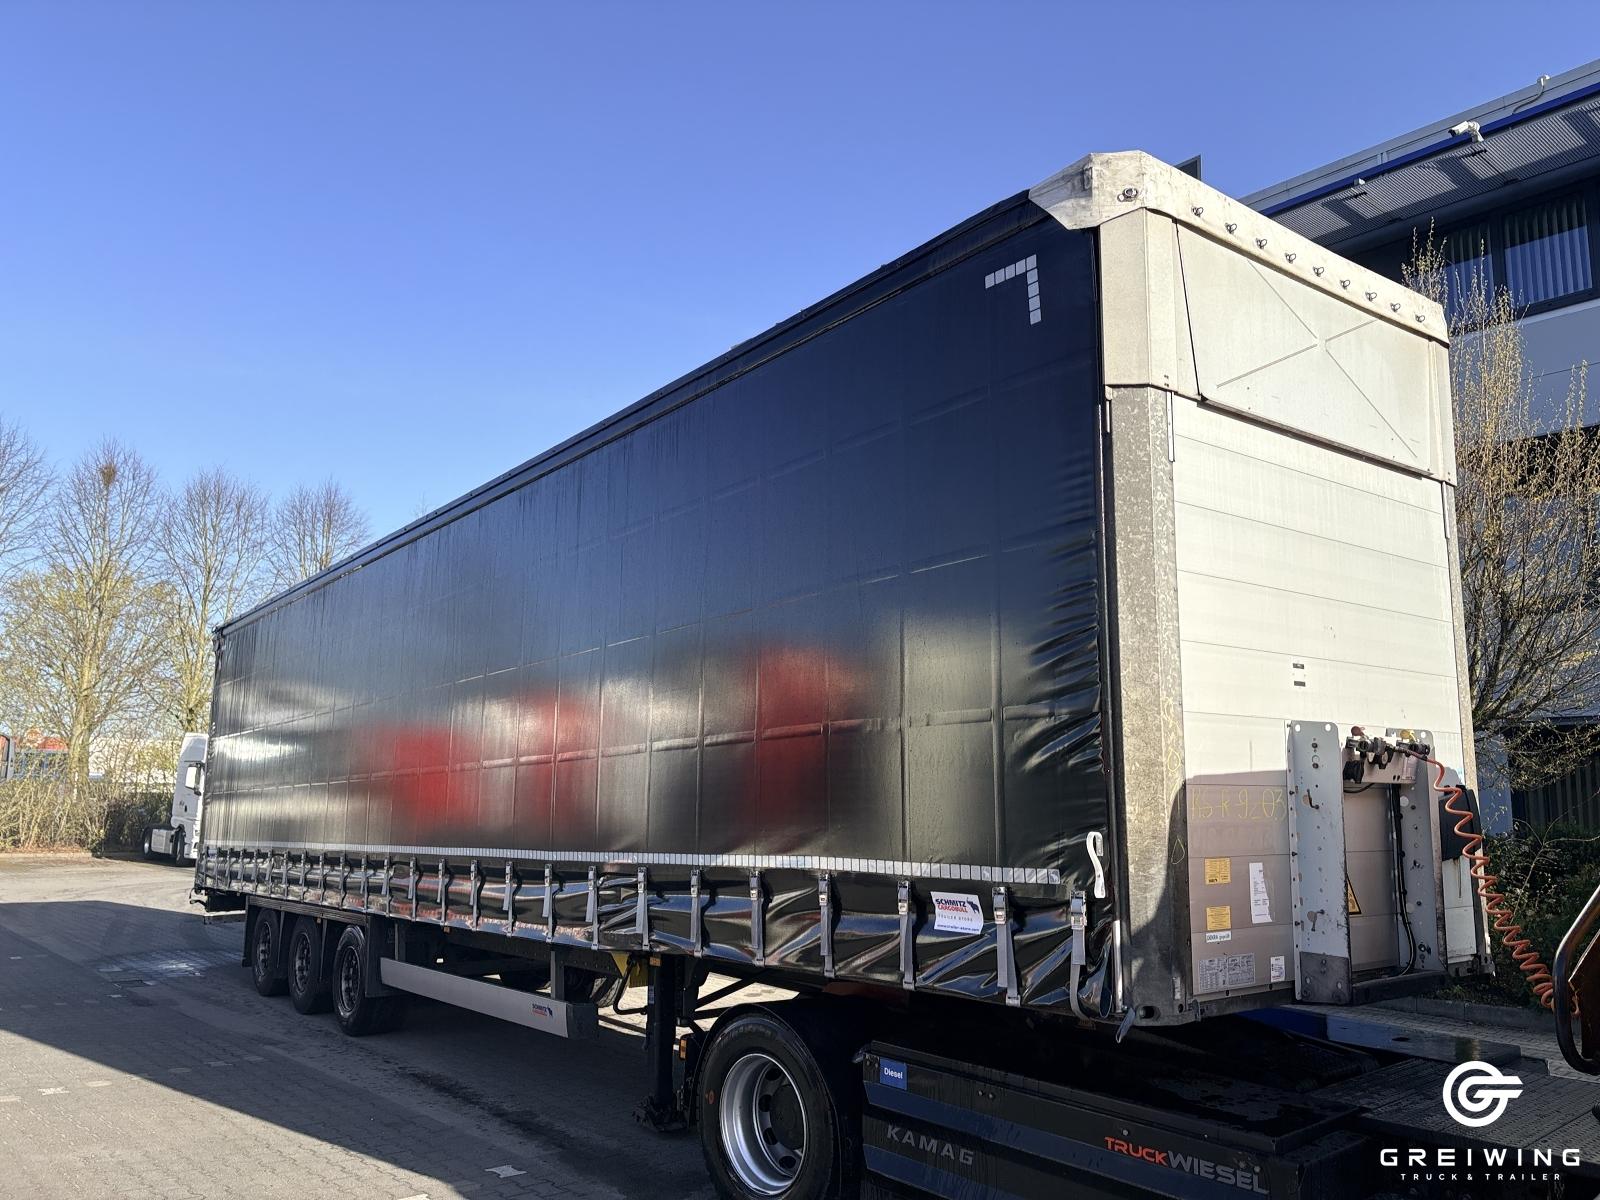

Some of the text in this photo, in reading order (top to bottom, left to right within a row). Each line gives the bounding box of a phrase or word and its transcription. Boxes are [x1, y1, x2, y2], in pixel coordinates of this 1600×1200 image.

[935, 899, 967, 908] SCHMITZ
[883, 1067, 903, 1080] Diesel
[886, 1124, 974, 1166] KAMAG
